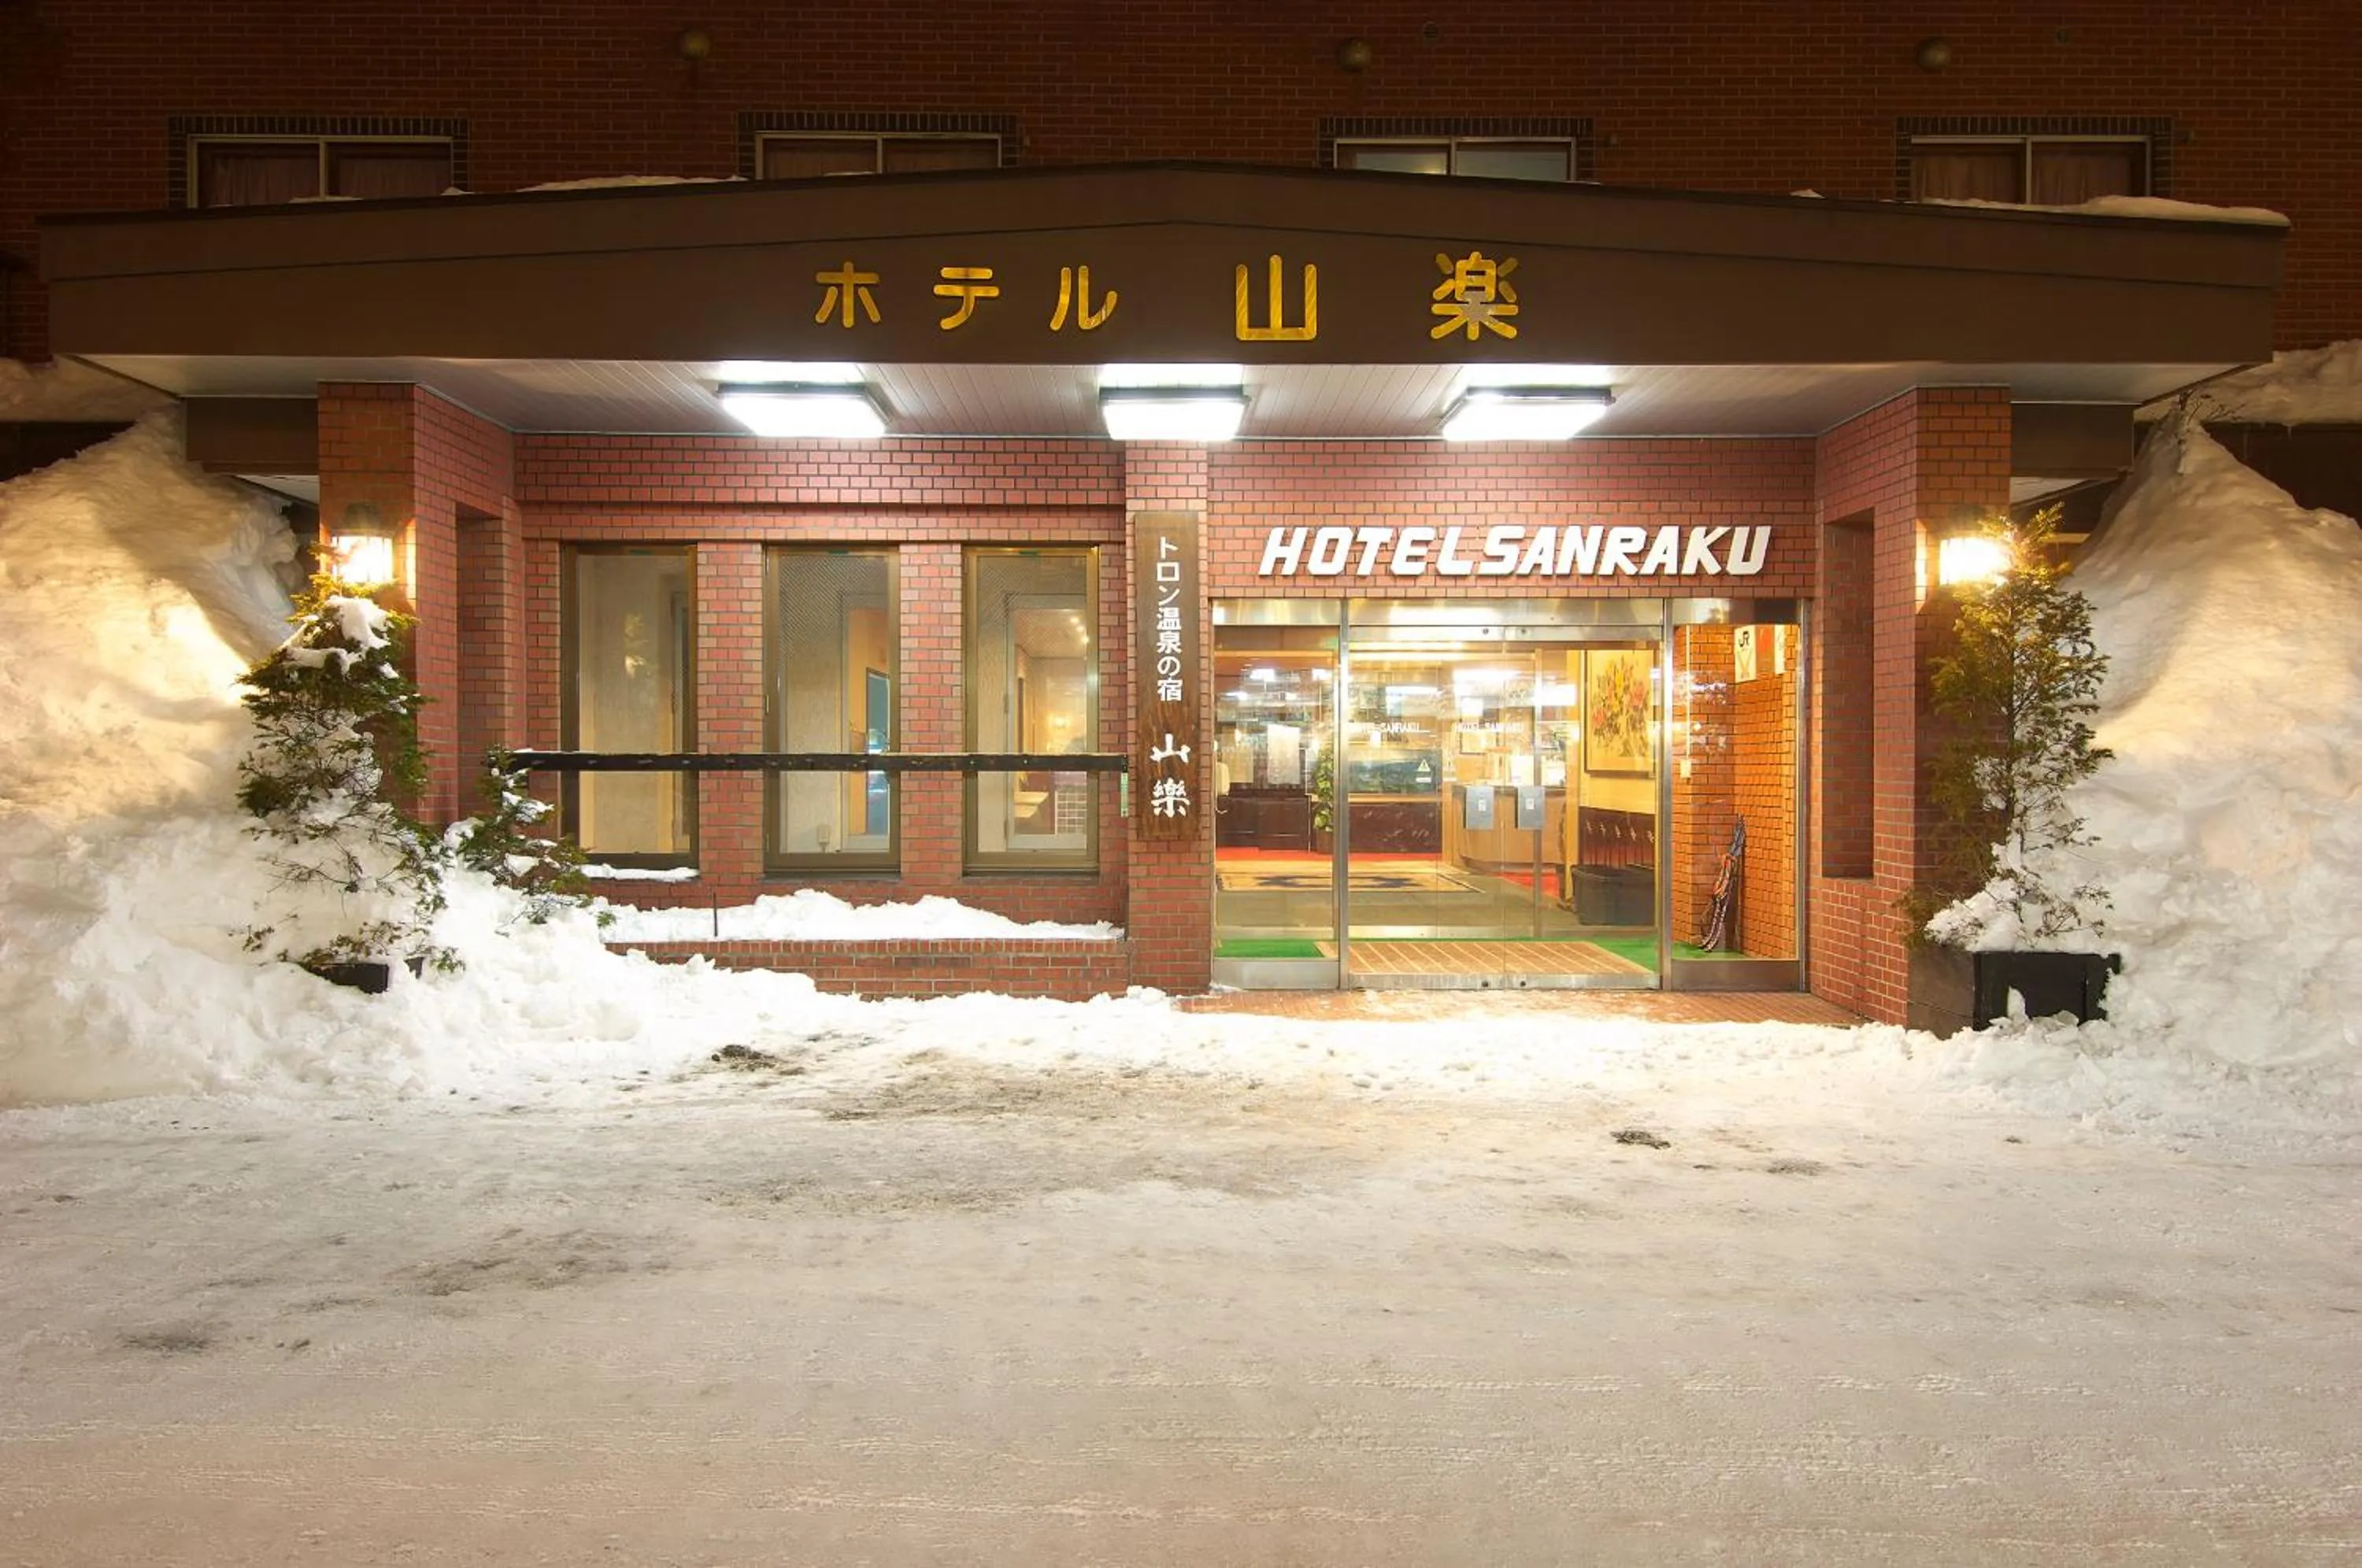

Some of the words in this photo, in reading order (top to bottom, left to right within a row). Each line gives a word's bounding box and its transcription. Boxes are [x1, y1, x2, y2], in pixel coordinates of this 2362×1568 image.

[815, 261, 1117, 331] ホテル
[1235, 250, 1519, 341] 山楽
[1156, 536, 1183, 701] トロン温泉の宿
